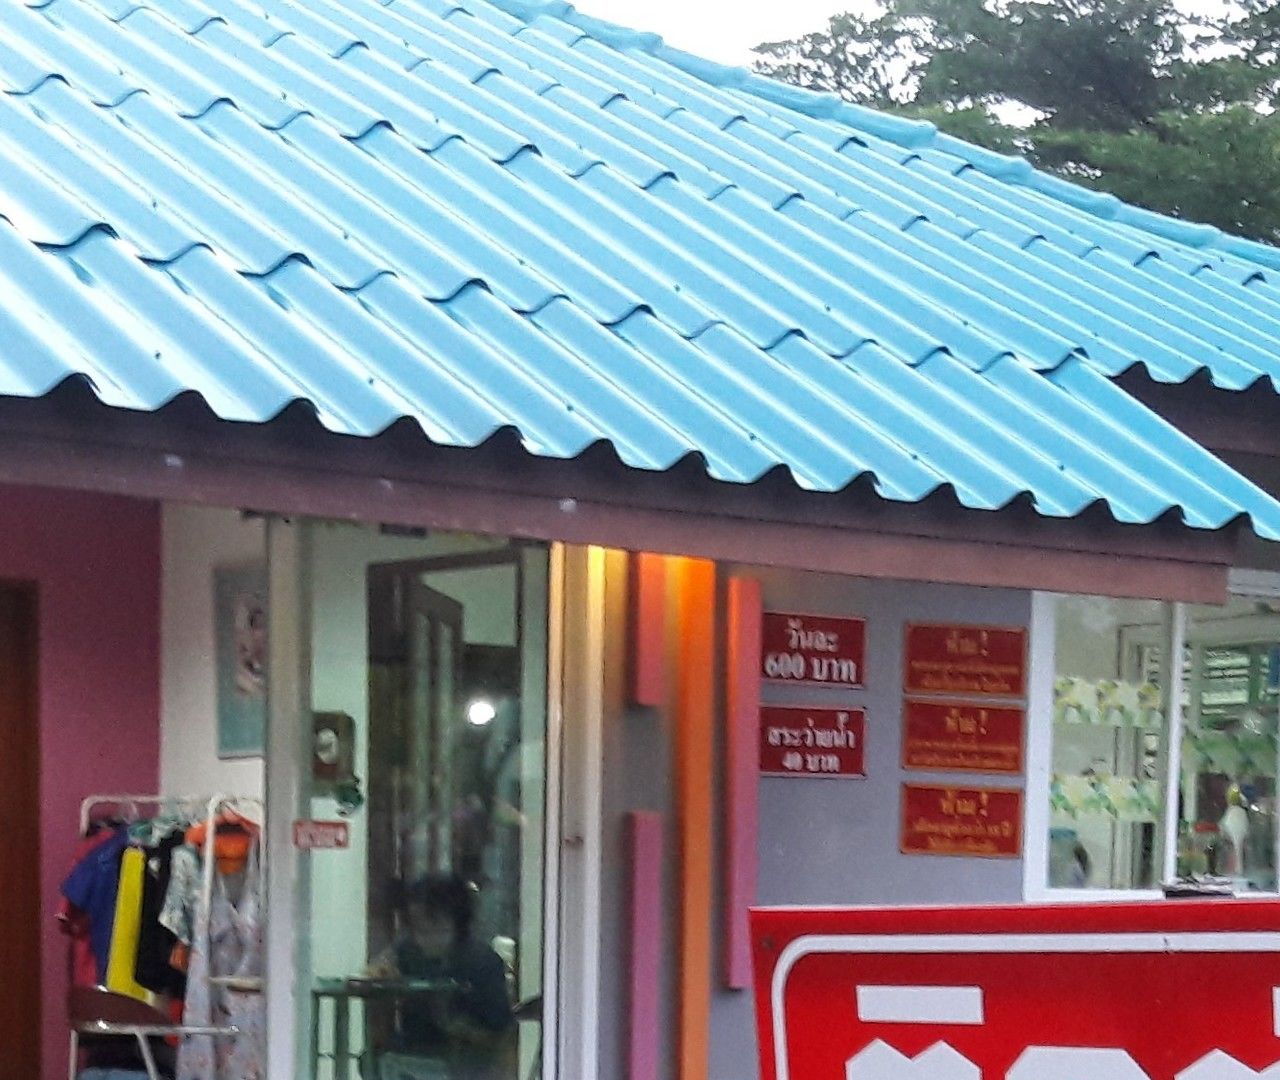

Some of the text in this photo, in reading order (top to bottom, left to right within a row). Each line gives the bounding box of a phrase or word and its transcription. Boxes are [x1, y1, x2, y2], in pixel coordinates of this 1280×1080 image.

[785, 617, 839, 652] วันละ
[764, 651, 857, 683] 600 บาท
[767, 711, 856, 749] สระว่ายน้ำ
[805, 753, 840, 773] บาท
